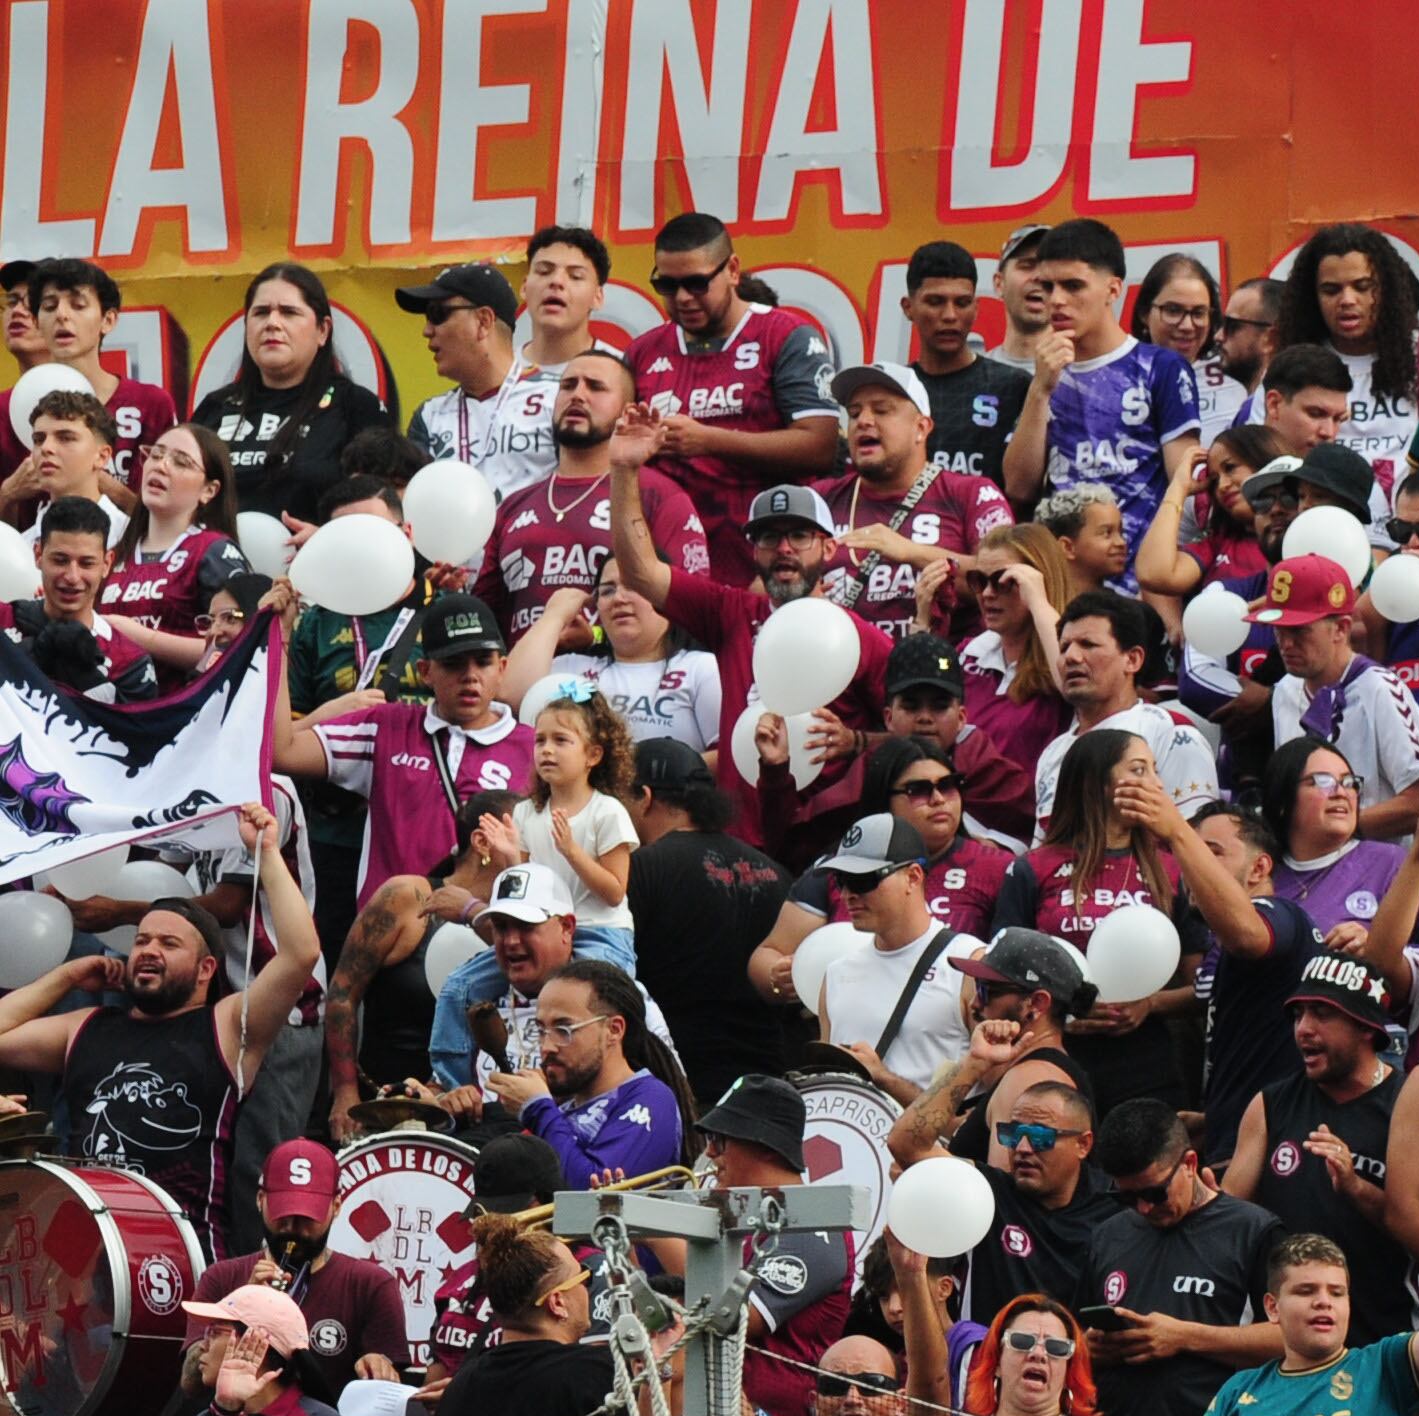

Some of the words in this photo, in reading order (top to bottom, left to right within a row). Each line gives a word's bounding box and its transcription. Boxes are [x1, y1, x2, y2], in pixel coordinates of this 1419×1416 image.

[0, 0, 232, 262] LA
[290, 0, 888, 250] REINA
[948, 0, 1196, 214] DE
[734, 341, 759, 370] S
[689, 383, 745, 408] BAC
[1121, 389, 1150, 427] S
[971, 394, 999, 427] S
[1346, 400, 1410, 423] BAC
[102, 449, 131, 475] AC
[937, 450, 984, 475] BAC
[1075, 437, 1139, 469] BAC
[544, 546, 611, 576] BAC
[123, 578, 169, 601] BAC
[541, 574, 599, 587] CREDOMAT
[1271, 570, 1292, 604] S
[610, 696, 676, 719] BAC
[478, 760, 512, 791] S
[1093, 889, 1152, 906] BAC
[290, 1158, 312, 1185] S
[388, 1144, 422, 1174] DE
[420, 1148, 466, 1186] LOS
[148, 1258, 169, 1308] S
